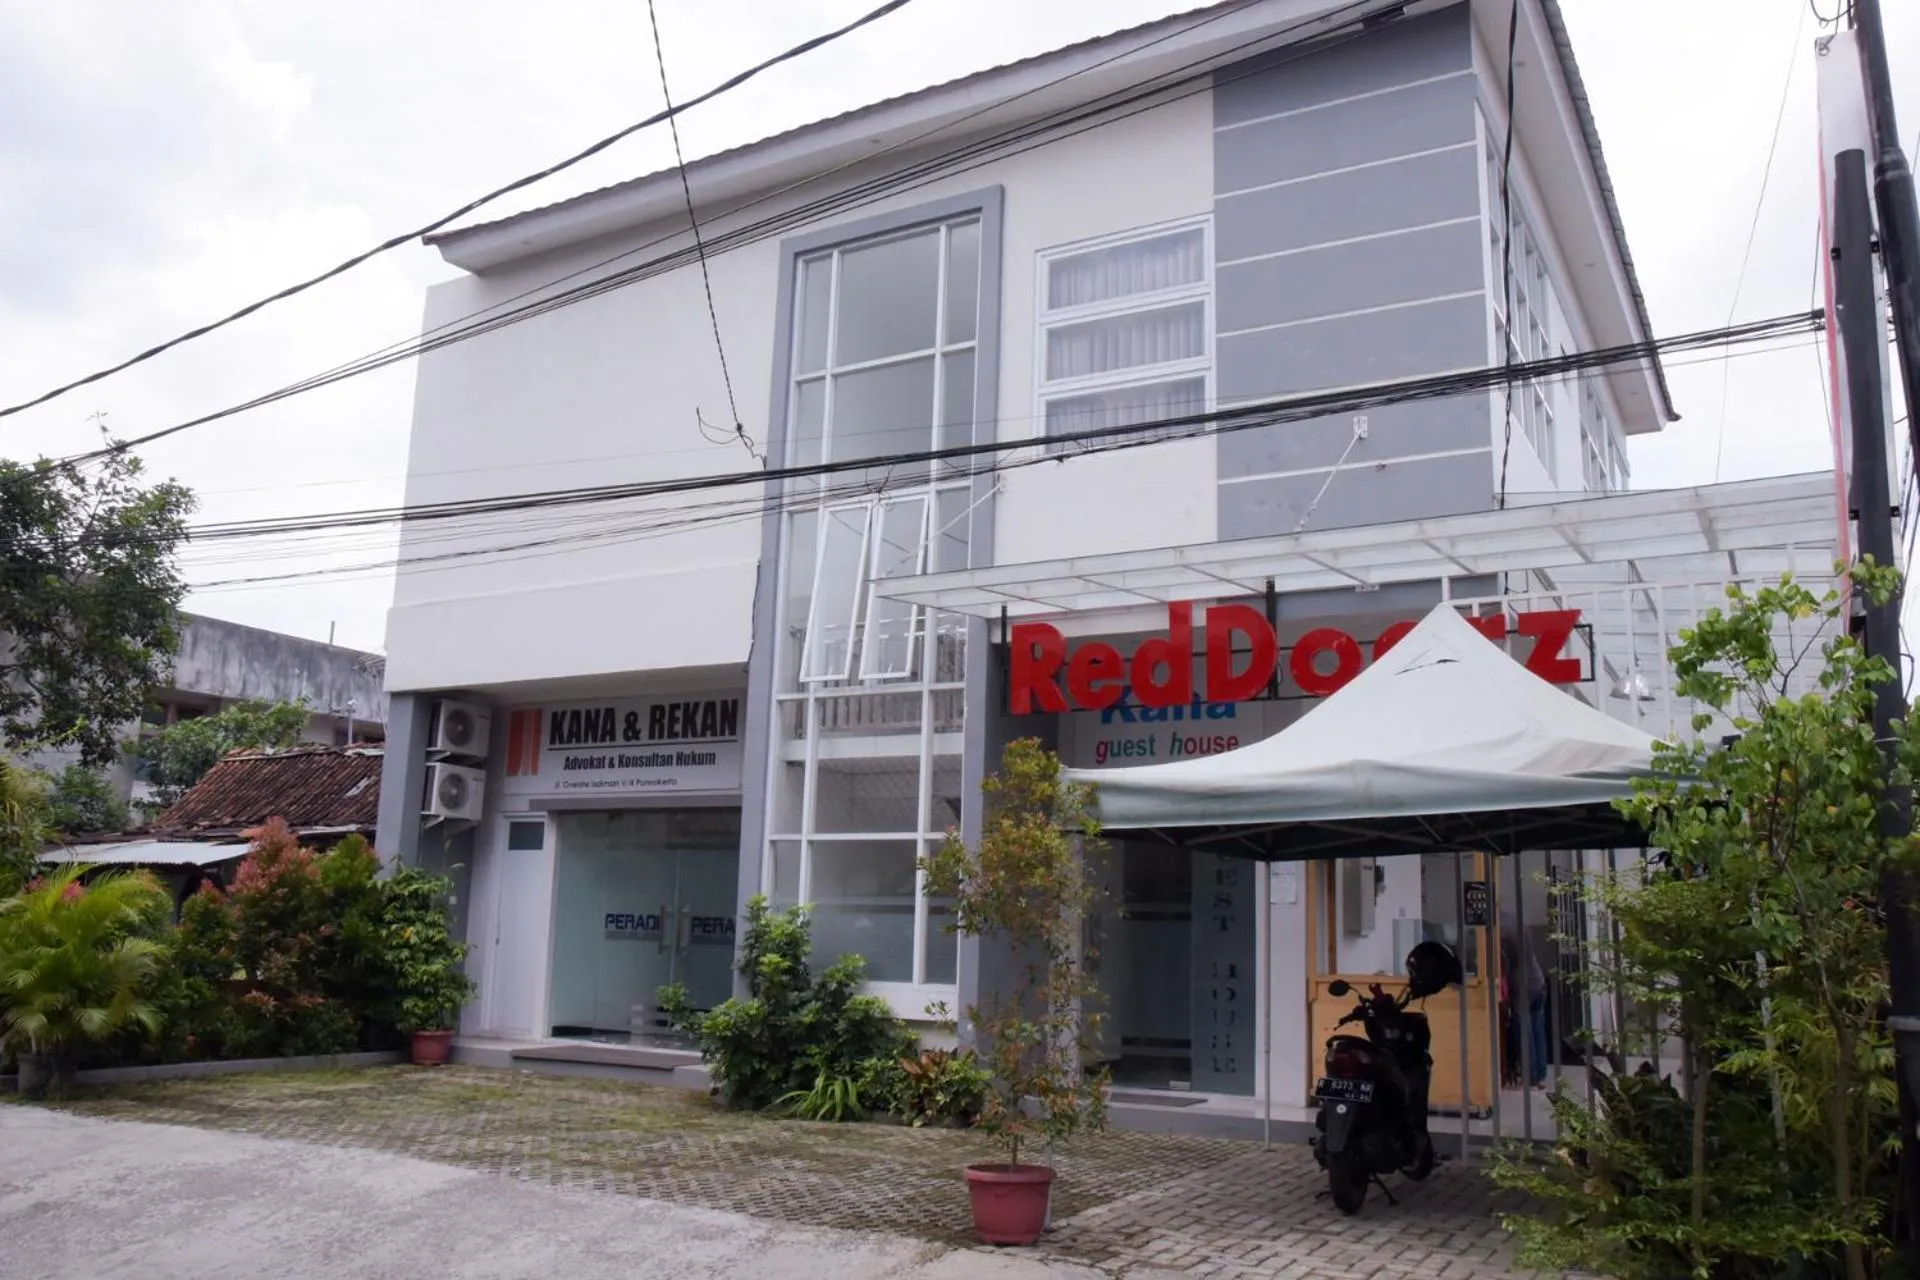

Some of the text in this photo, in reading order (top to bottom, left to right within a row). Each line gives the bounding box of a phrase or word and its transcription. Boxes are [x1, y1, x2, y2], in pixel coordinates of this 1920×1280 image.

[1010, 600, 1583, 717] RedDoz
[550, 698, 739, 745] KANA & REKAN
[564, 751, 716, 771] Advokat & Konsultan Hukum
[1095, 731, 1239, 766] guest house
[604, 913, 660, 931] PERADI
